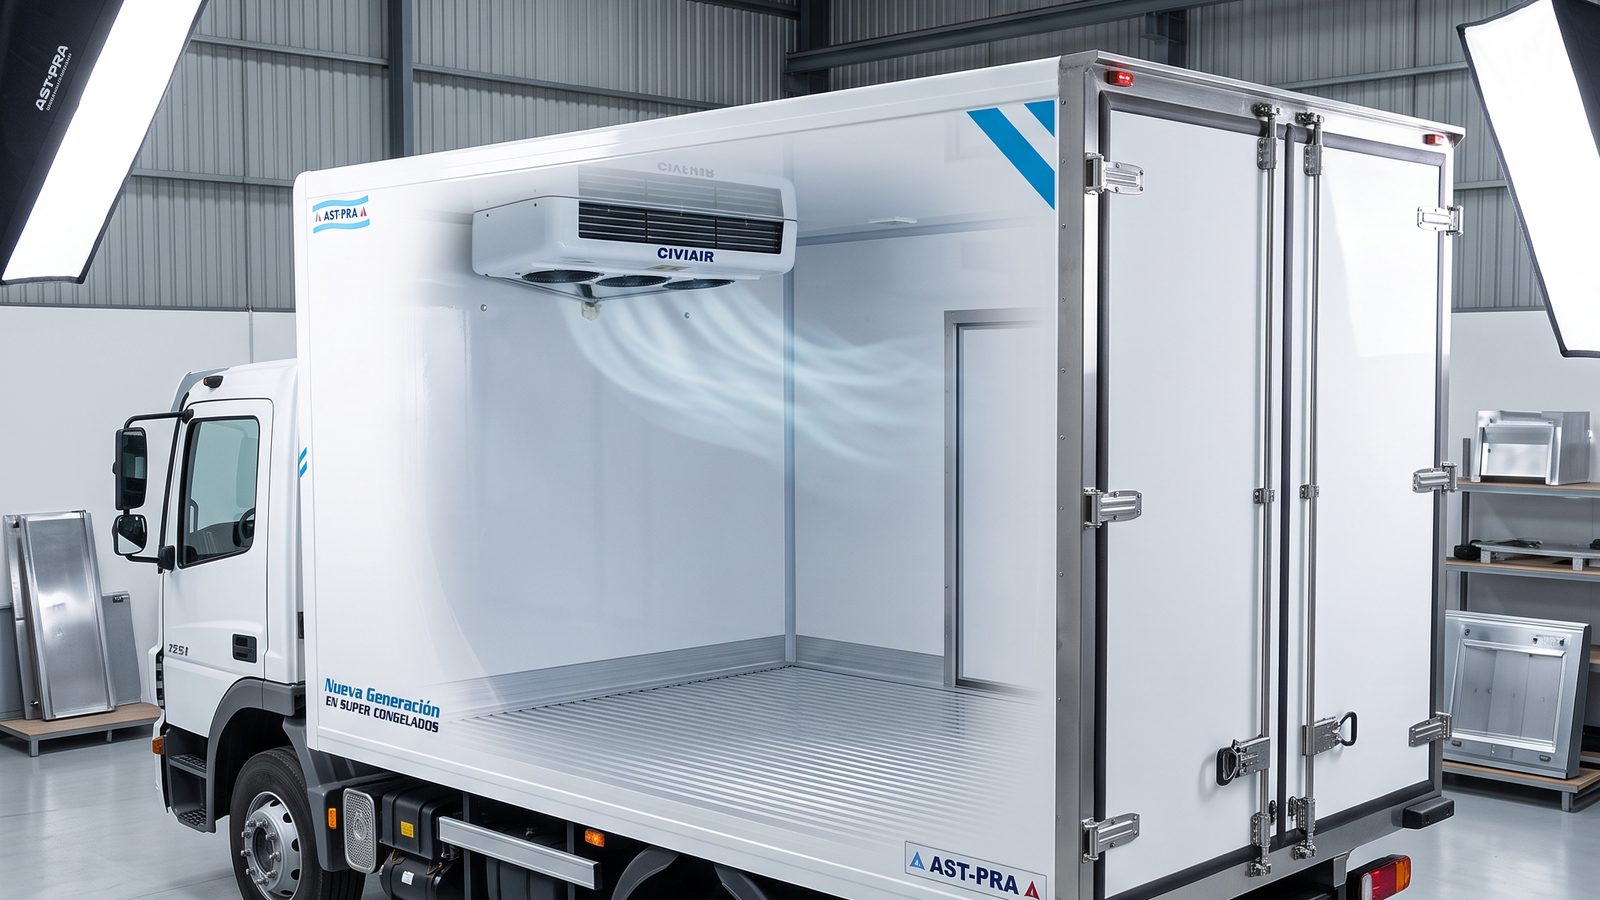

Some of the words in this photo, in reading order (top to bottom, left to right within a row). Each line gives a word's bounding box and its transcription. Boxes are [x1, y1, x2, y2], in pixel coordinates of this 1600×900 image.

[657, 247, 715, 262] CIVIAIR
[324, 677, 363, 700] Nueva
[366, 687, 441, 719] Generación
[325, 695, 339, 708] EN
[340, 699, 371, 716] SUPER
[373, 707, 439, 733] CONGELADOS
[929, 855, 1020, 896] AST-PRA
